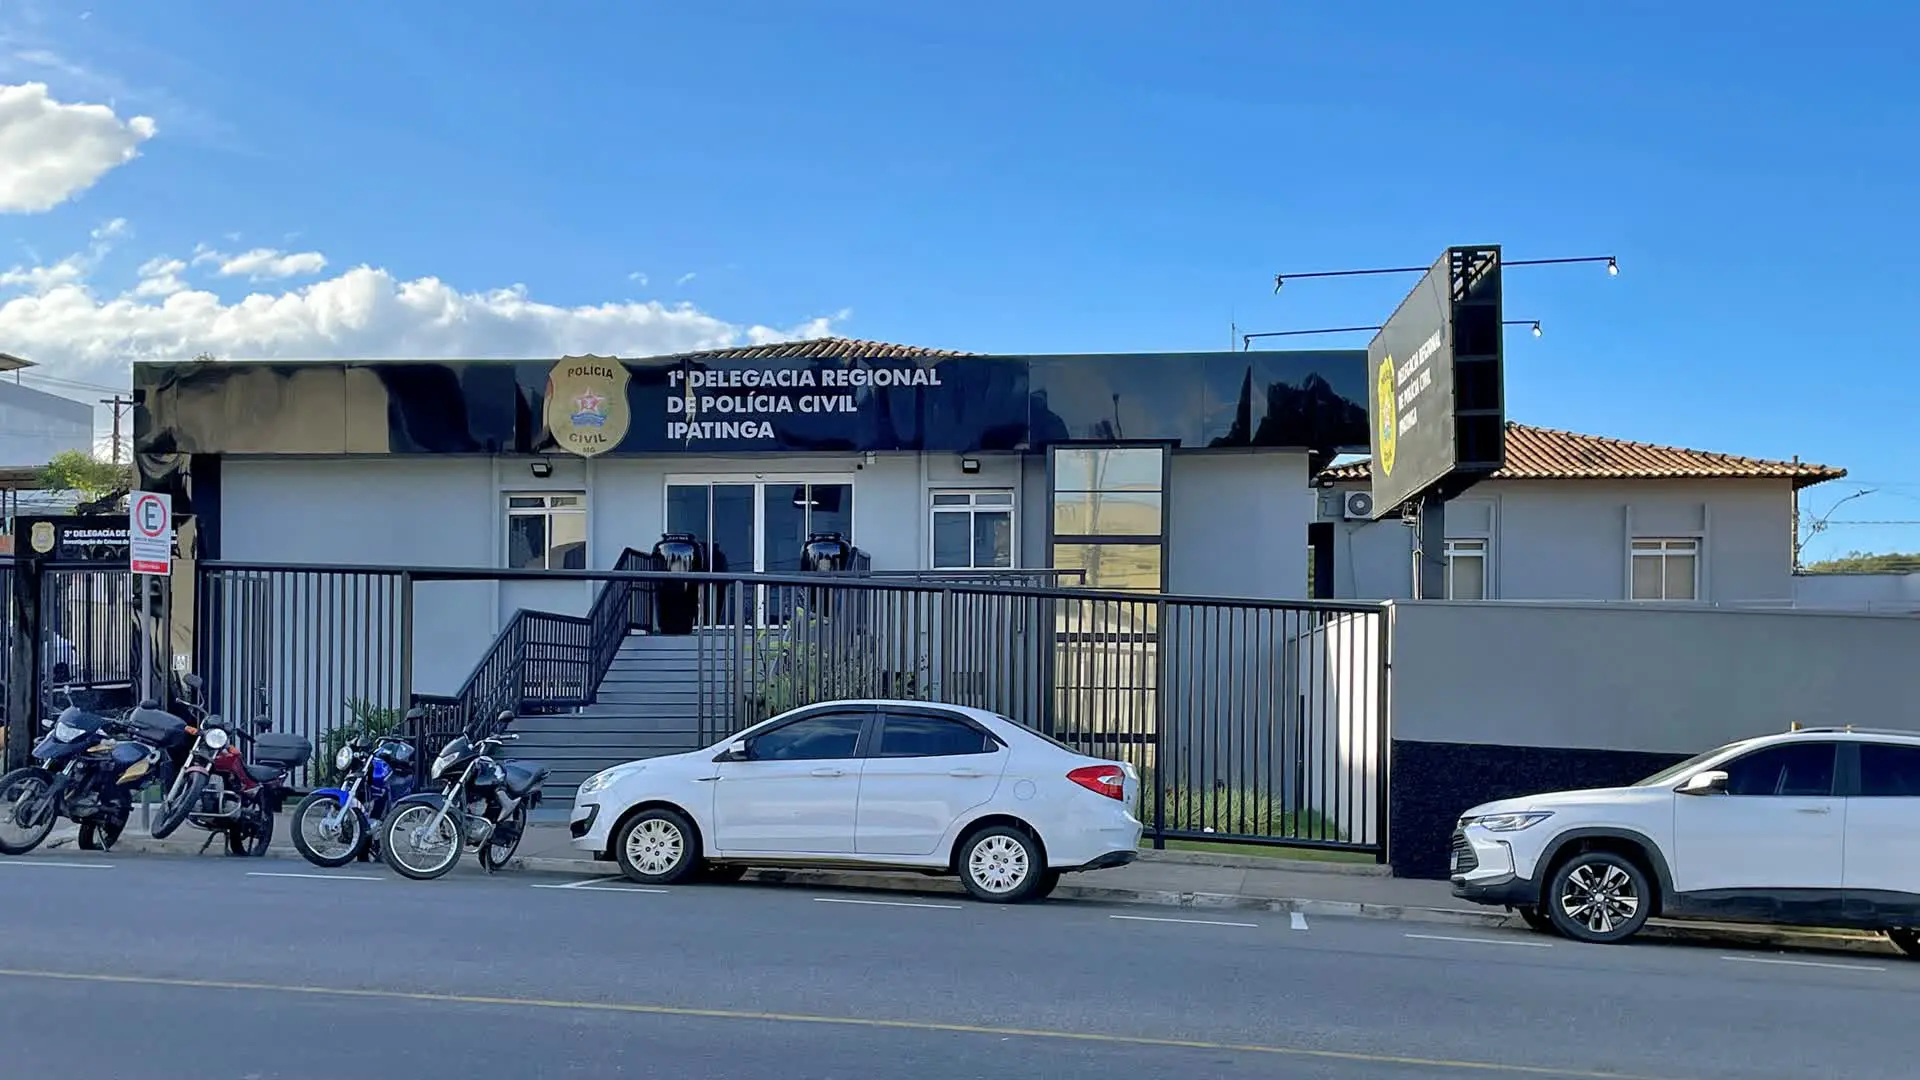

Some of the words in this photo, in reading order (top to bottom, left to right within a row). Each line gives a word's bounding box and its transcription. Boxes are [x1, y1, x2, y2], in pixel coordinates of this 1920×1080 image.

[567, 363, 614, 379] POLÍCIA
[667, 370, 685, 388] 1ª
[689, 369, 817, 388] DELEGACIA
[822, 368, 942, 387] REGIONAL
[667, 396, 697, 413] DE
[701, 390, 794, 413] POLÍCIA
[798, 395, 858, 413] CIVIL
[569, 433, 608, 444] CIVIL
[667, 421, 776, 439] IPATINGA
[145, 501, 158, 530] E
